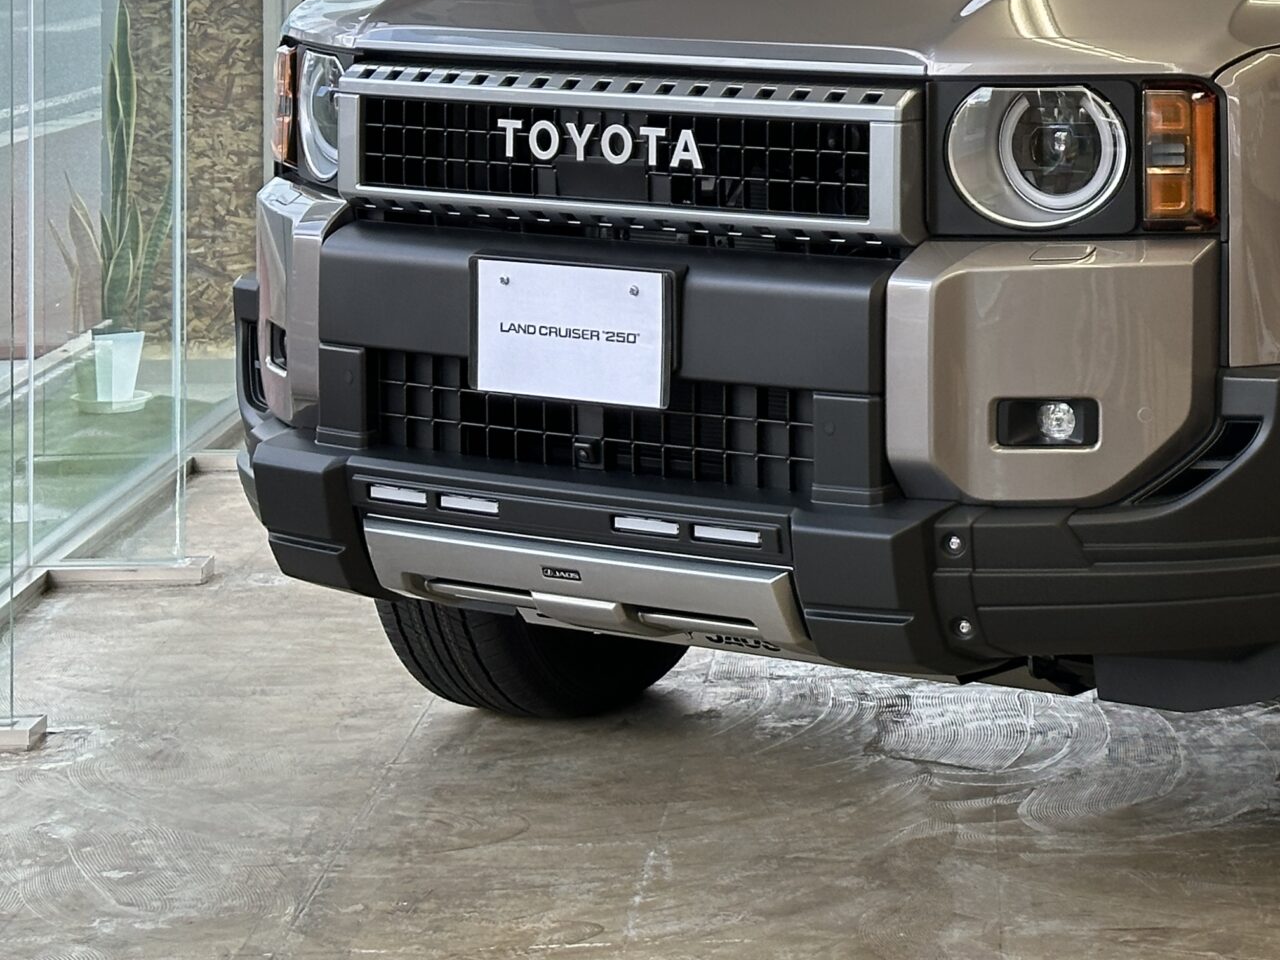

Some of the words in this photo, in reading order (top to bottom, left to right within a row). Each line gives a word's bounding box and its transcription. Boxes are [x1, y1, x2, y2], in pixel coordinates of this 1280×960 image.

[497, 118, 703, 170] TOYOTA
[500, 321, 536, 335] LAND
[539, 325, 600, 341] CRUISER
